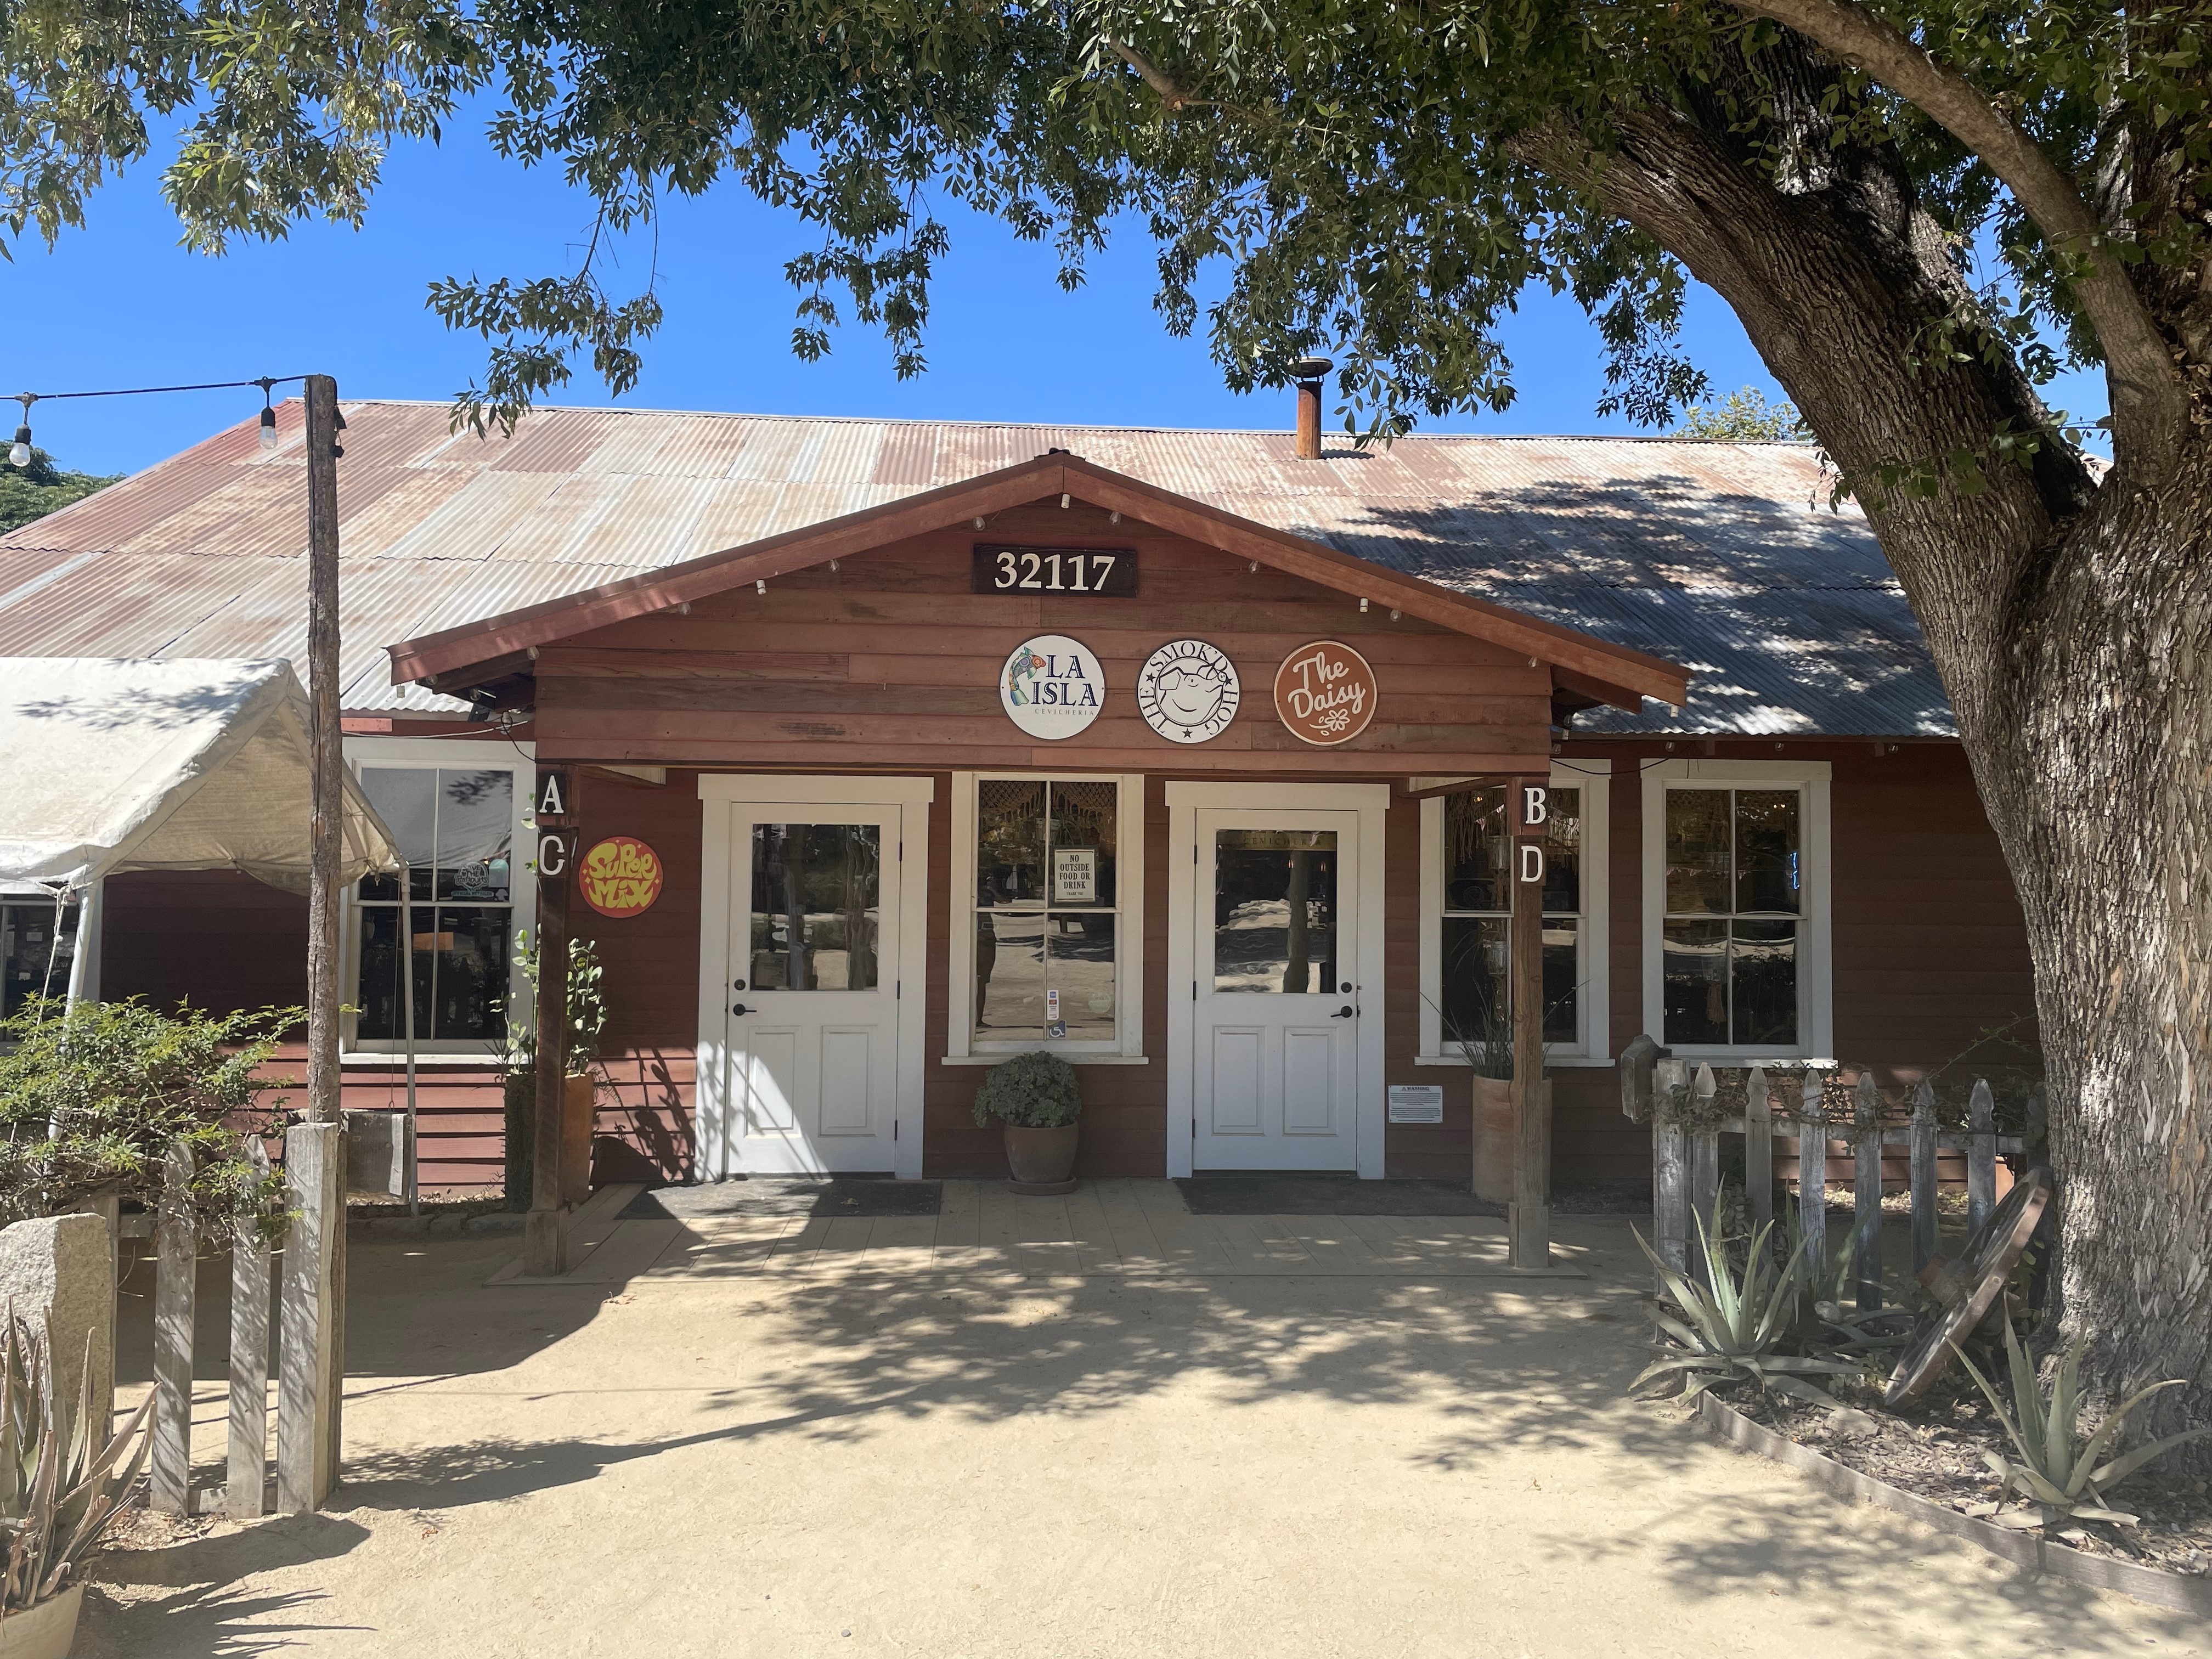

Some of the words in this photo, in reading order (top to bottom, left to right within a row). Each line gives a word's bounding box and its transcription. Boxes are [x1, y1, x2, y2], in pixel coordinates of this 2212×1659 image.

[995, 552, 1115, 590] 32117
[1046, 654, 1086, 679] LA
[1293, 651, 1349, 690] The
[1031, 681, 1099, 707] ISLA
[1140, 687, 1169, 733] THE
[1204, 690, 1238, 735] HOG
[1288, 682, 1366, 718] Daisy
[539, 775, 565, 814] A
[1524, 787, 1547, 824] B
[539, 835, 565, 876] C
[1521, 845, 1543, 882] D
